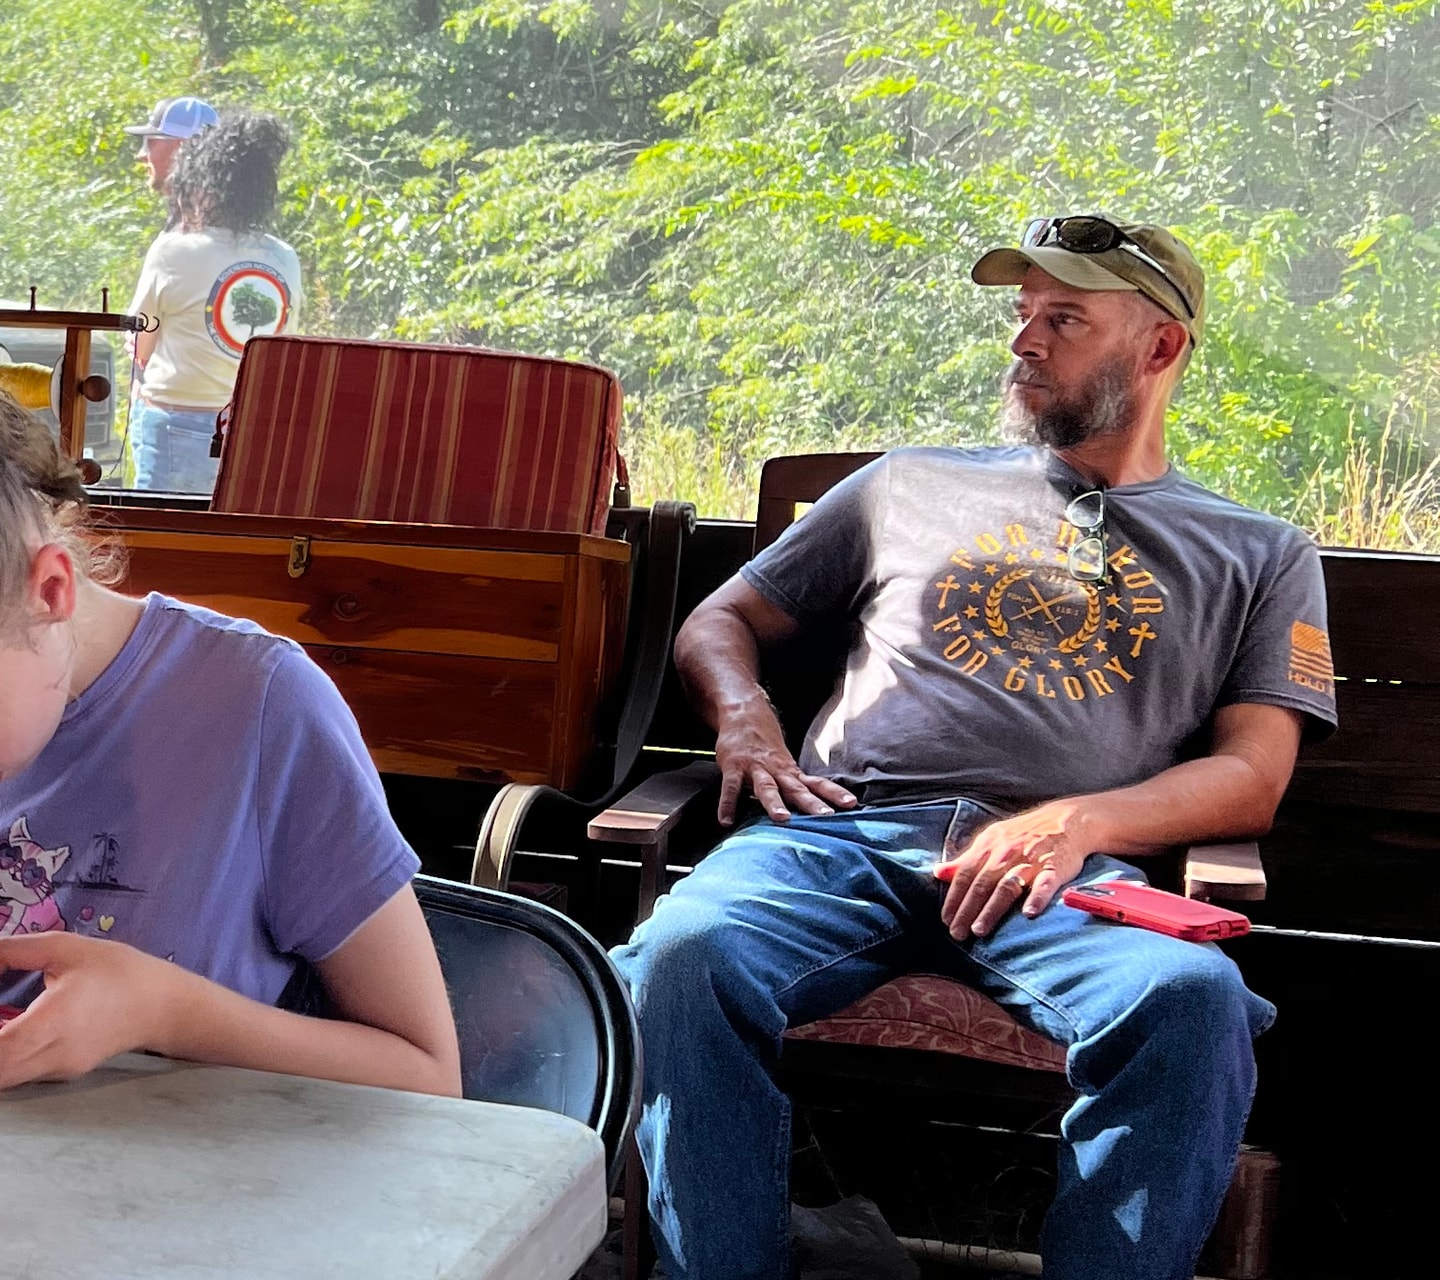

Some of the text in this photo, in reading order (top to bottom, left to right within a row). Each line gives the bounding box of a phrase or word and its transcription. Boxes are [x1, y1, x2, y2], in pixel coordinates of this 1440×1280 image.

[950, 520, 1164, 615] FOR HNOR
[933, 613, 1136, 701] FOR GLORY
